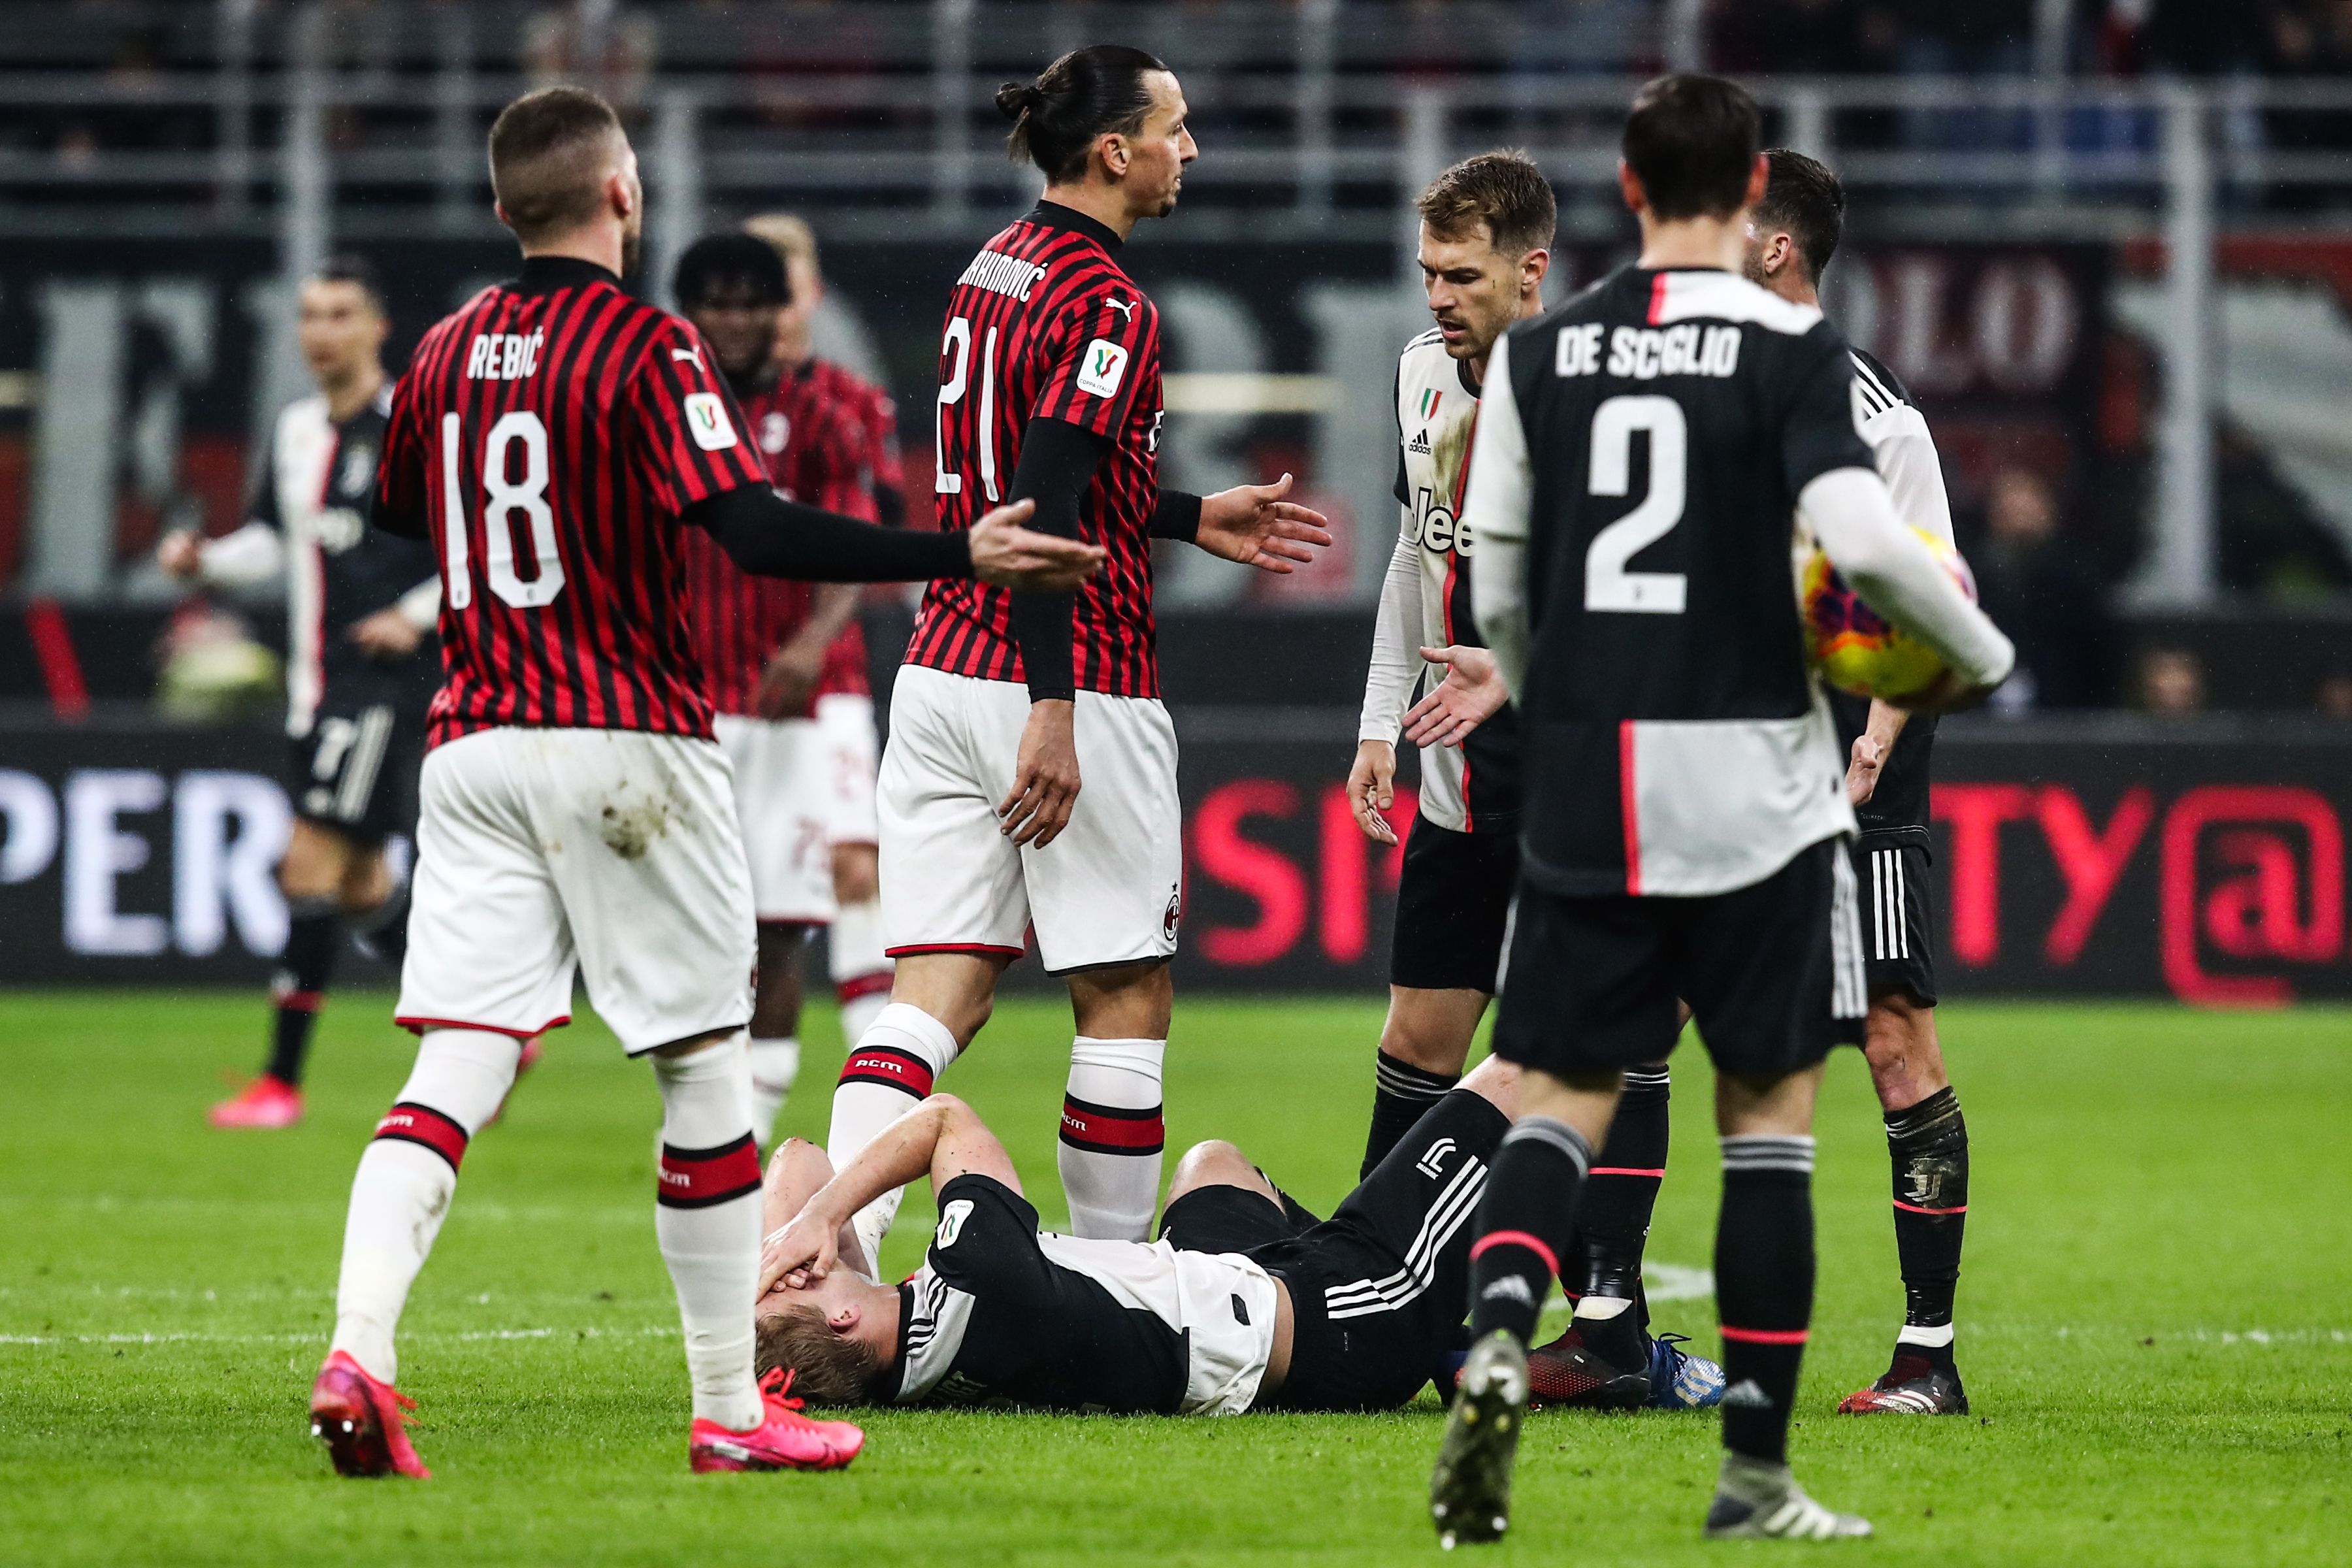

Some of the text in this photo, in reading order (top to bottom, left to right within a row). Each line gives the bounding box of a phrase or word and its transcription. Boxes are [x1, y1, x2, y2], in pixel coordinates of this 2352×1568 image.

[468, 327, 544, 380] REBIĆ
[1556, 323, 1604, 378] DE
[935, 316, 998, 502] 21
[1079, 378, 1112, 393] COPPA ITALIA
[1409, 443, 1431, 455] adidas
[443, 411, 565, 610] 18
[1411, 486, 1474, 557] Jee
[1584, 395, 1688, 614] 2
